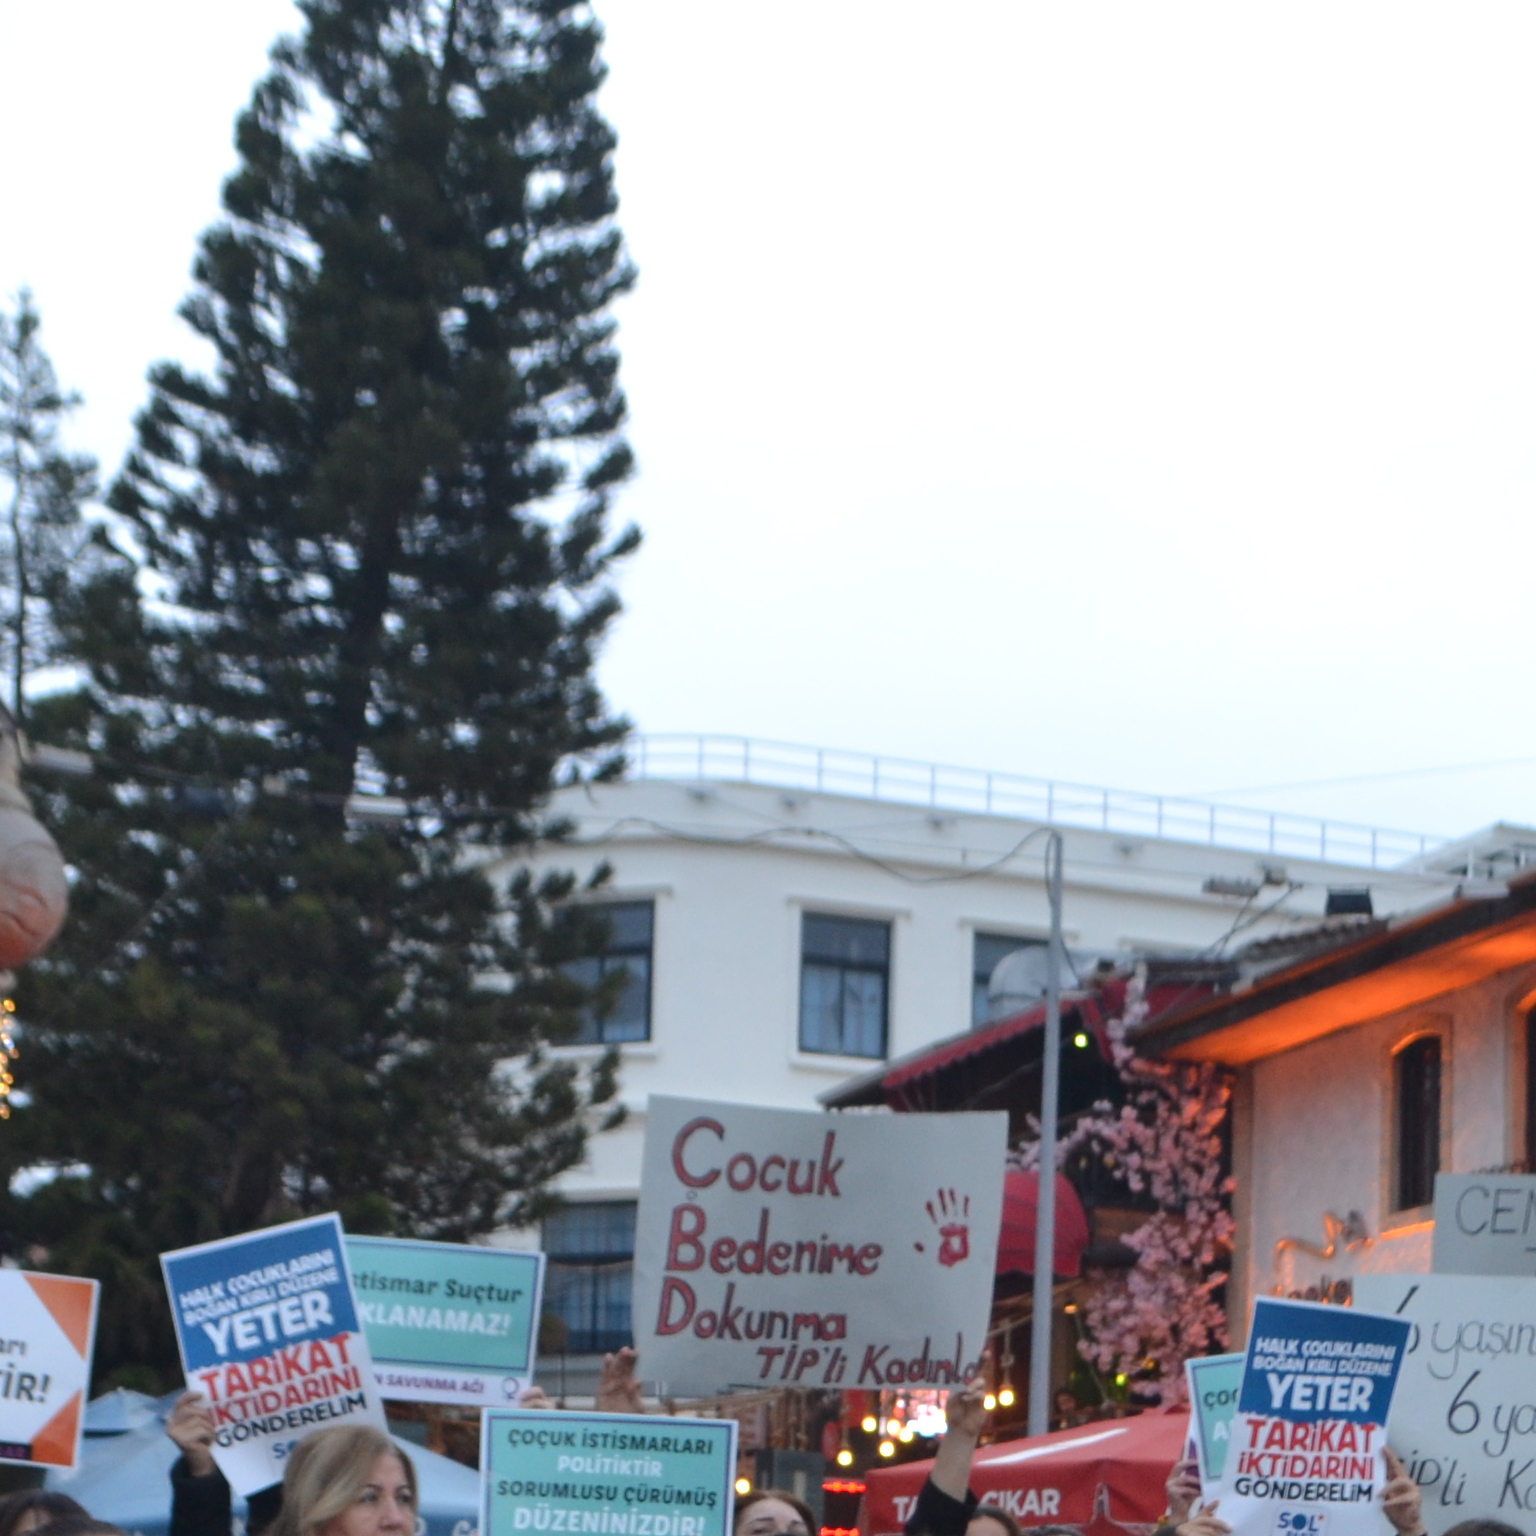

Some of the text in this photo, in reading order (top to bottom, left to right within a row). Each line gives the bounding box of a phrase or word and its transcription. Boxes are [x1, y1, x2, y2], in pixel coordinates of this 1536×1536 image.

[666, 1203, 882, 1275] Bedenime
[178, 1249, 336, 1310] HALK ÇOCUKLARINI
[278, 1266, 341, 1297] DÜZENE
[351, 1271, 524, 1305] stismar Suçtur
[201, 1290, 335, 1357] YETER
[361, 1304, 512, 1337] KLANAMAZ!
[656, 1276, 846, 1341] Dokunma
[200, 1331, 352, 1401] TARİKAT
[858, 1332, 978, 1385] Kadınla
[1253, 1354, 1305, 1373] BOĞAN
[1338, 1357, 1393, 1377] DÜZENE
[1255, 1337, 1396, 1362] HALK ÇOCUKLARINI
[386, 1374, 456, 1394] SAVUNMA
[459, 1377, 485, 1395] AĞI
[1266, 1372, 1375, 1413] YETER
[1447, 1369, 1481, 1435] 6
[216, 1391, 368, 1448] GÖNDERELİM
[582, 1428, 714, 1455] İSTİSMARLARI
[1247, 1419, 1377, 1454] TARİKAT
[557, 1453, 662, 1477] POLİTİKTİR
[1238, 1451, 1375, 1481] İKTİDARINI
[497, 1481, 717, 1510] SORUMLUSU ÇÜRÜMÜŞ
[1235, 1475, 1373, 1503] GÖNDERELİM
[1277, 1512, 1320, 1532] SOL
